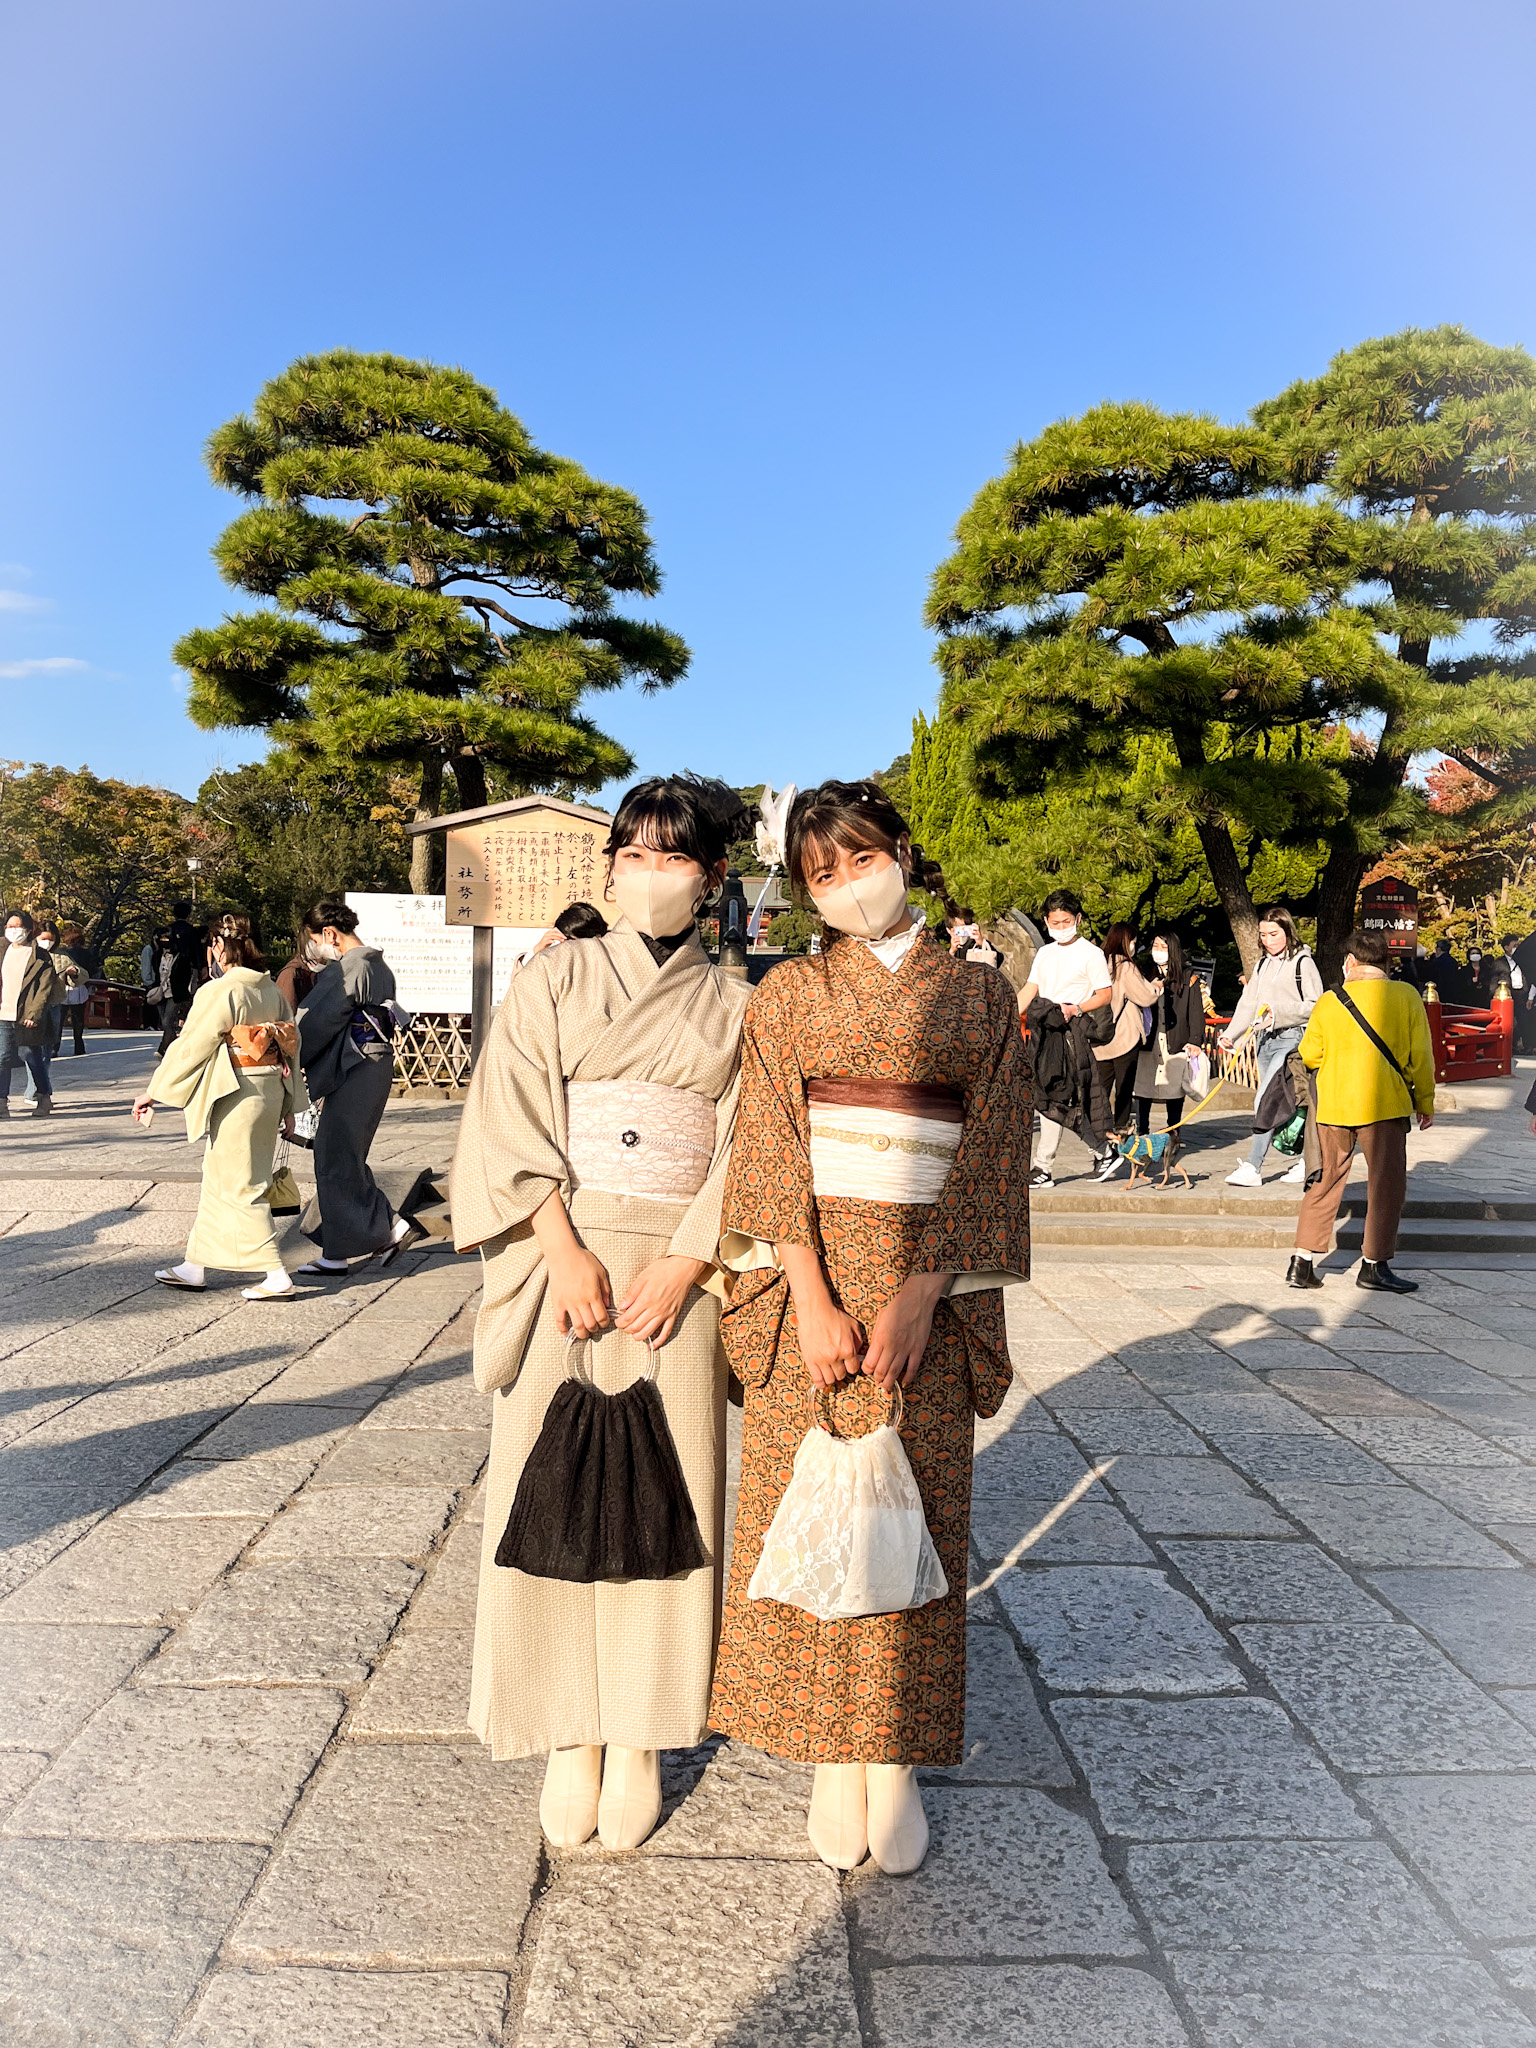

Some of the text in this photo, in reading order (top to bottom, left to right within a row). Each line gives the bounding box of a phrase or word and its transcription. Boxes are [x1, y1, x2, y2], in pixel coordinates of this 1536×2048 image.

[553, 832, 565, 885] 禁止します
[566, 832, 580, 906] 於いて左の行
[580, 832, 596, 906] 鶴岡八幡宮境
[457, 867, 474, 919] 社務所
[1364, 918, 1416, 931] 鶴岡八幡宮
